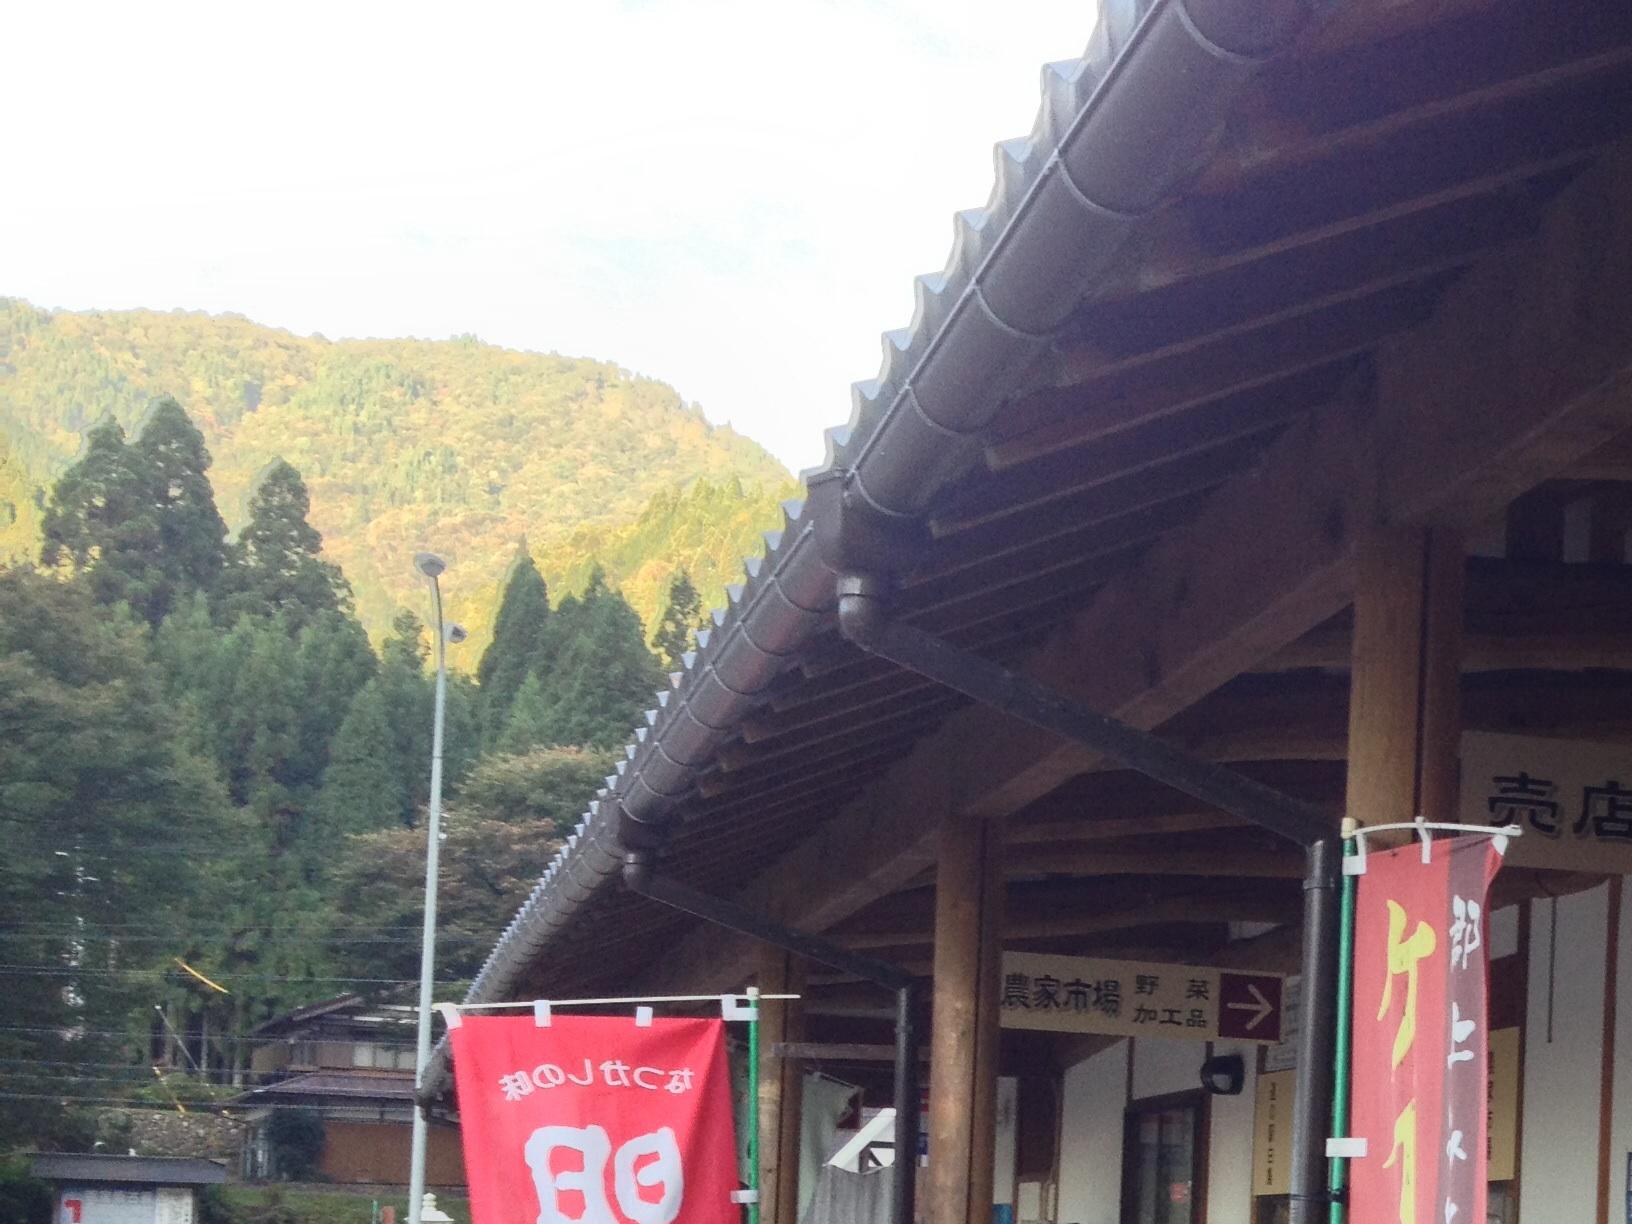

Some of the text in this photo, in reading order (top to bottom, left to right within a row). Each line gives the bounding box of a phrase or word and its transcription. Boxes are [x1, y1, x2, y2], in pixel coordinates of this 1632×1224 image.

[1002, 973, 1121, 1017] 農家市場
[1133, 1003, 1208, 1028] 加工品
